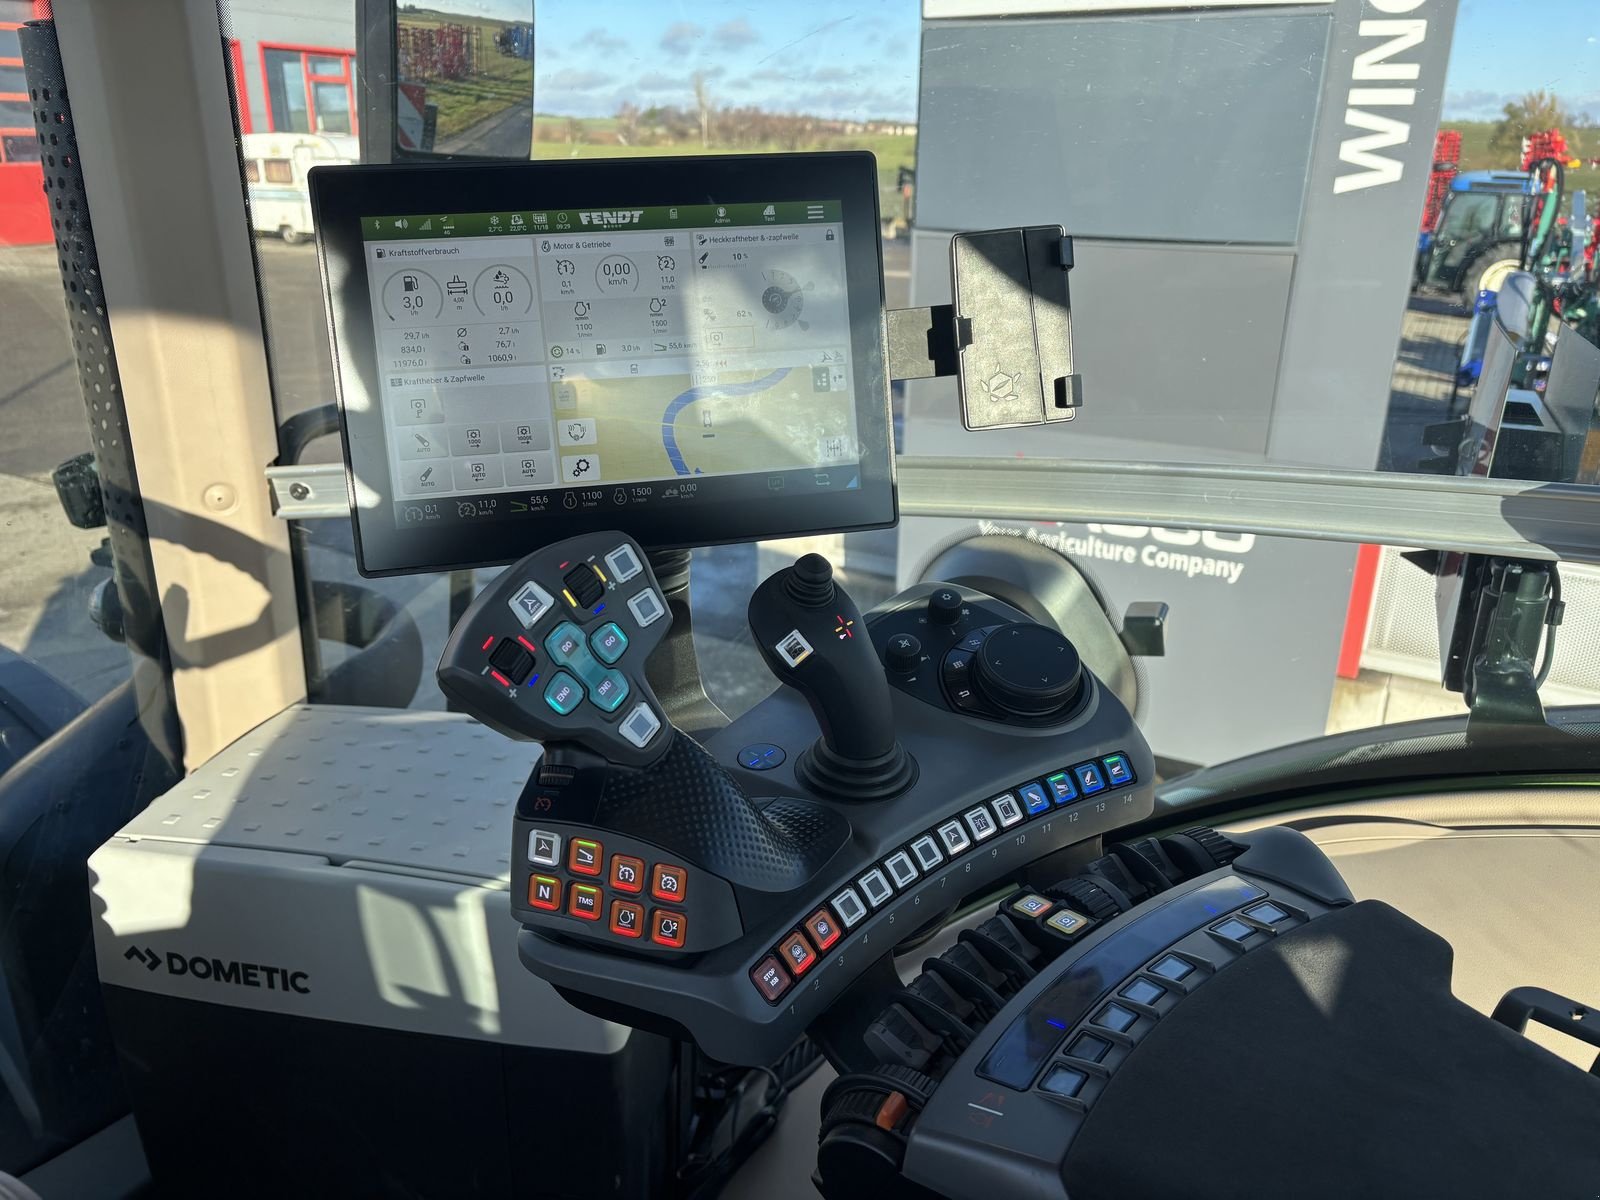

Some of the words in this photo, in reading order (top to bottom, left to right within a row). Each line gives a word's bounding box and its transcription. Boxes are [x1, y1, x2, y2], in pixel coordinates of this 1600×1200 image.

[1333, 0, 1428, 194] WIN
[579, 211, 644, 224] FENDT
[709, 235, 759, 244] Heckkraftheber
[553, 242, 574, 250] Motor
[582, 241, 611, 249] Getriebe
[389, 248, 460, 257] Kraftstoffverbrauch
[603, 263, 631, 277] 0,00
[608, 278, 628, 286] km/h
[661, 276, 675, 284] 11,0
[403, 296, 424, 309] 3,0
[494, 292, 513, 305] 0,0
[499, 327, 510, 335] 2,7
[404, 332, 420, 341] 29,7
[401, 346, 422, 354] 834,0
[496, 341, 511, 349] 76,7
[669, 342, 683, 350] 55,6
[488, 354, 513, 362] 1060,9
[393, 360, 424, 368] 11976,0
[404, 377, 442, 386] Kraftheber
[450, 374, 486, 383] Zapfwelle
[632, 487, 652, 496] 1500
[680, 483, 697, 492] 0,00
[530, 496, 549, 505] 55,6
[582, 491, 602, 500] 1100
[425, 505, 437, 513] 0,1
[478, 500, 497, 509] 11,0
[1141, 545, 1244, 584] Company
[562, 641, 573, 652] GO
[605, 636, 616, 647] GO
[598, 680, 612, 696] END
[556, 686, 570, 703] END
[1123, 794, 1132, 804] 14
[1096, 803, 1106, 813] 13
[1068, 812, 1079, 823] 12
[1042, 824, 1051, 833] 11
[1016, 835, 1026, 846] 10
[991, 849, 998, 858] 9
[965, 863, 971, 873] 8
[940, 877, 946, 888] 7
[539, 885, 550, 899] N
[578, 896, 594, 906] TMS
[914, 896, 920, 905] 6
[889, 913, 895, 924] 5
[863, 934, 869, 944] 4
[838, 956, 844, 967] 3
[166, 952, 311, 994] DOMETIC
[763, 968, 776, 982] STOP
[814, 979, 820, 991] 2
